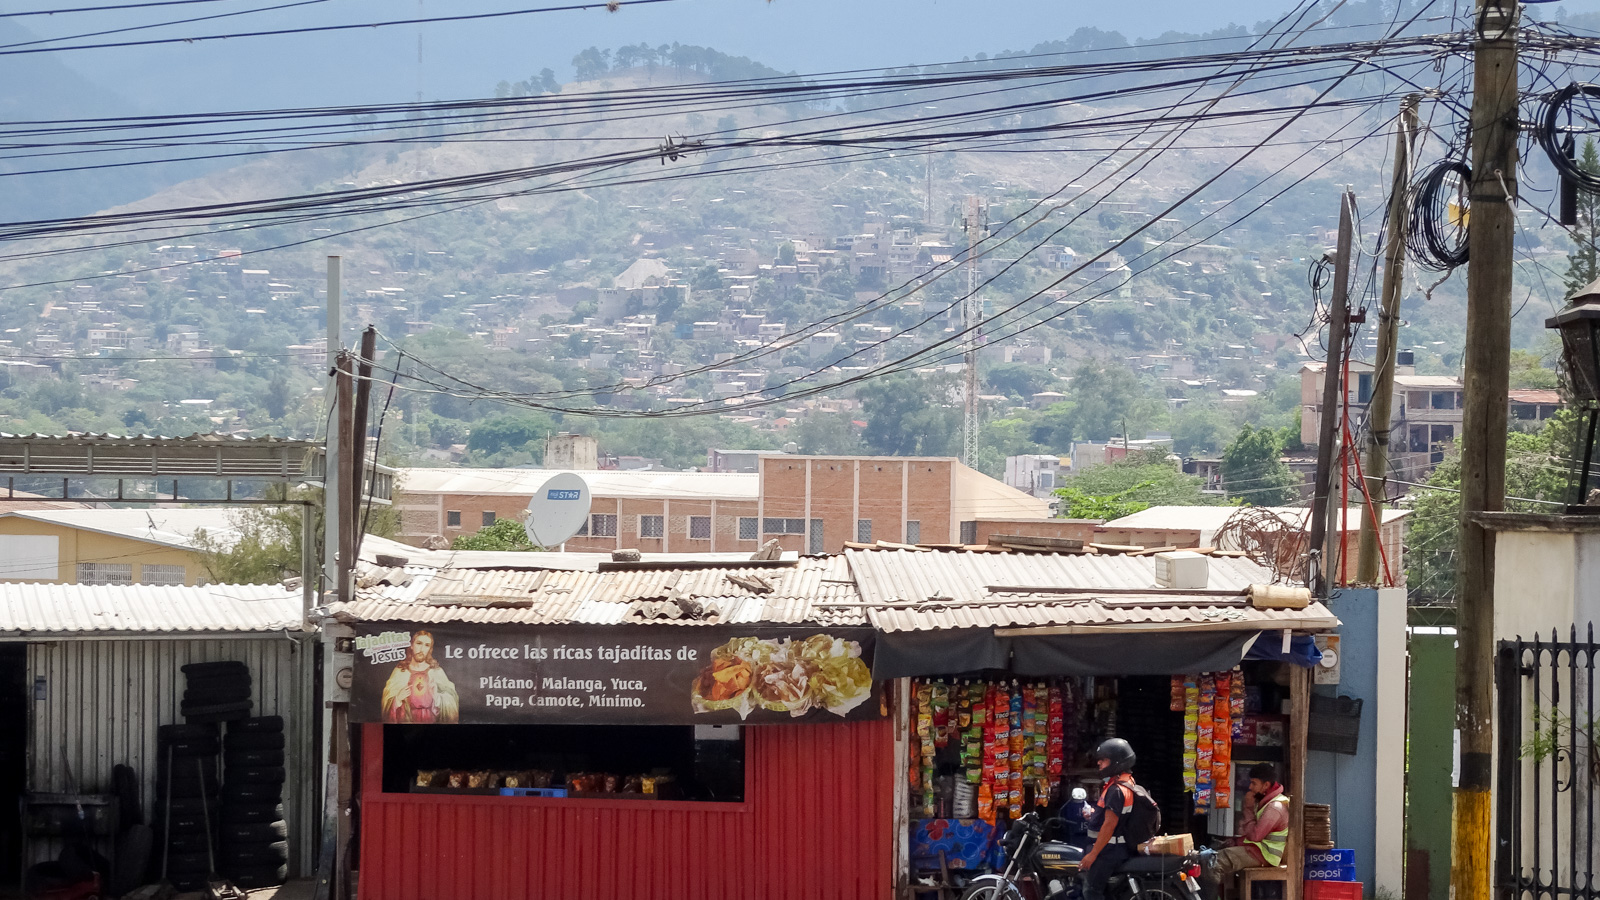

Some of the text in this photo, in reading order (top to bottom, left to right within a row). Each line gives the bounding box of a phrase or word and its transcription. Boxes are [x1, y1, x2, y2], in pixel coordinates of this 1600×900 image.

[356, 632, 410, 648] Tajaditas
[372, 648, 405, 662] Jesús
[445, 644, 697, 663] Le ofrece las ricas tajaditas de
[480, 676, 648, 693] Plátano, Malanga, Yuca,
[486, 694, 525, 709] Papa,
[528, 695, 585, 708] Camote,
[1310, 853, 1342, 864] pepsi
[1309, 868, 1342, 879] pepsi
